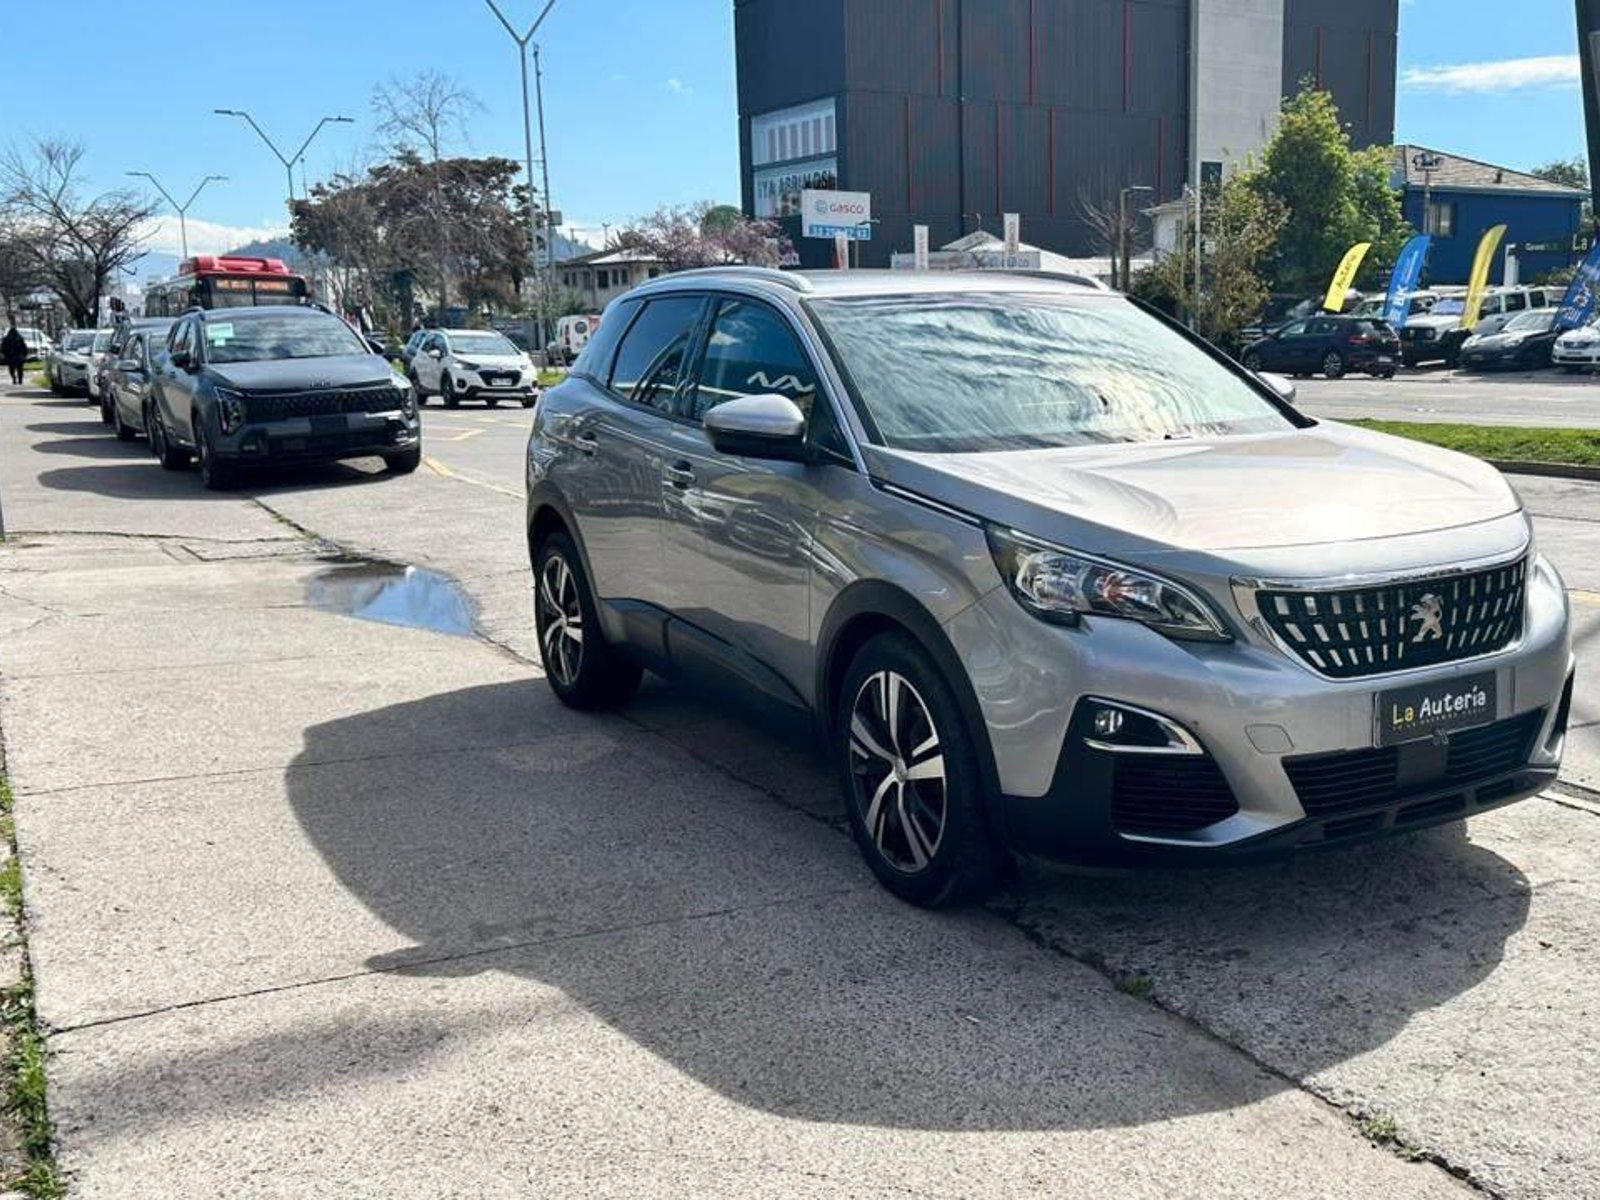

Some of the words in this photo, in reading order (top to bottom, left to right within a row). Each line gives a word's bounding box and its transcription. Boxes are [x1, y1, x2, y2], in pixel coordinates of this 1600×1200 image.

[1572, 233, 1588, 252] La
[1392, 703, 1415, 725] La
[1419, 685, 1487, 719] Autería
